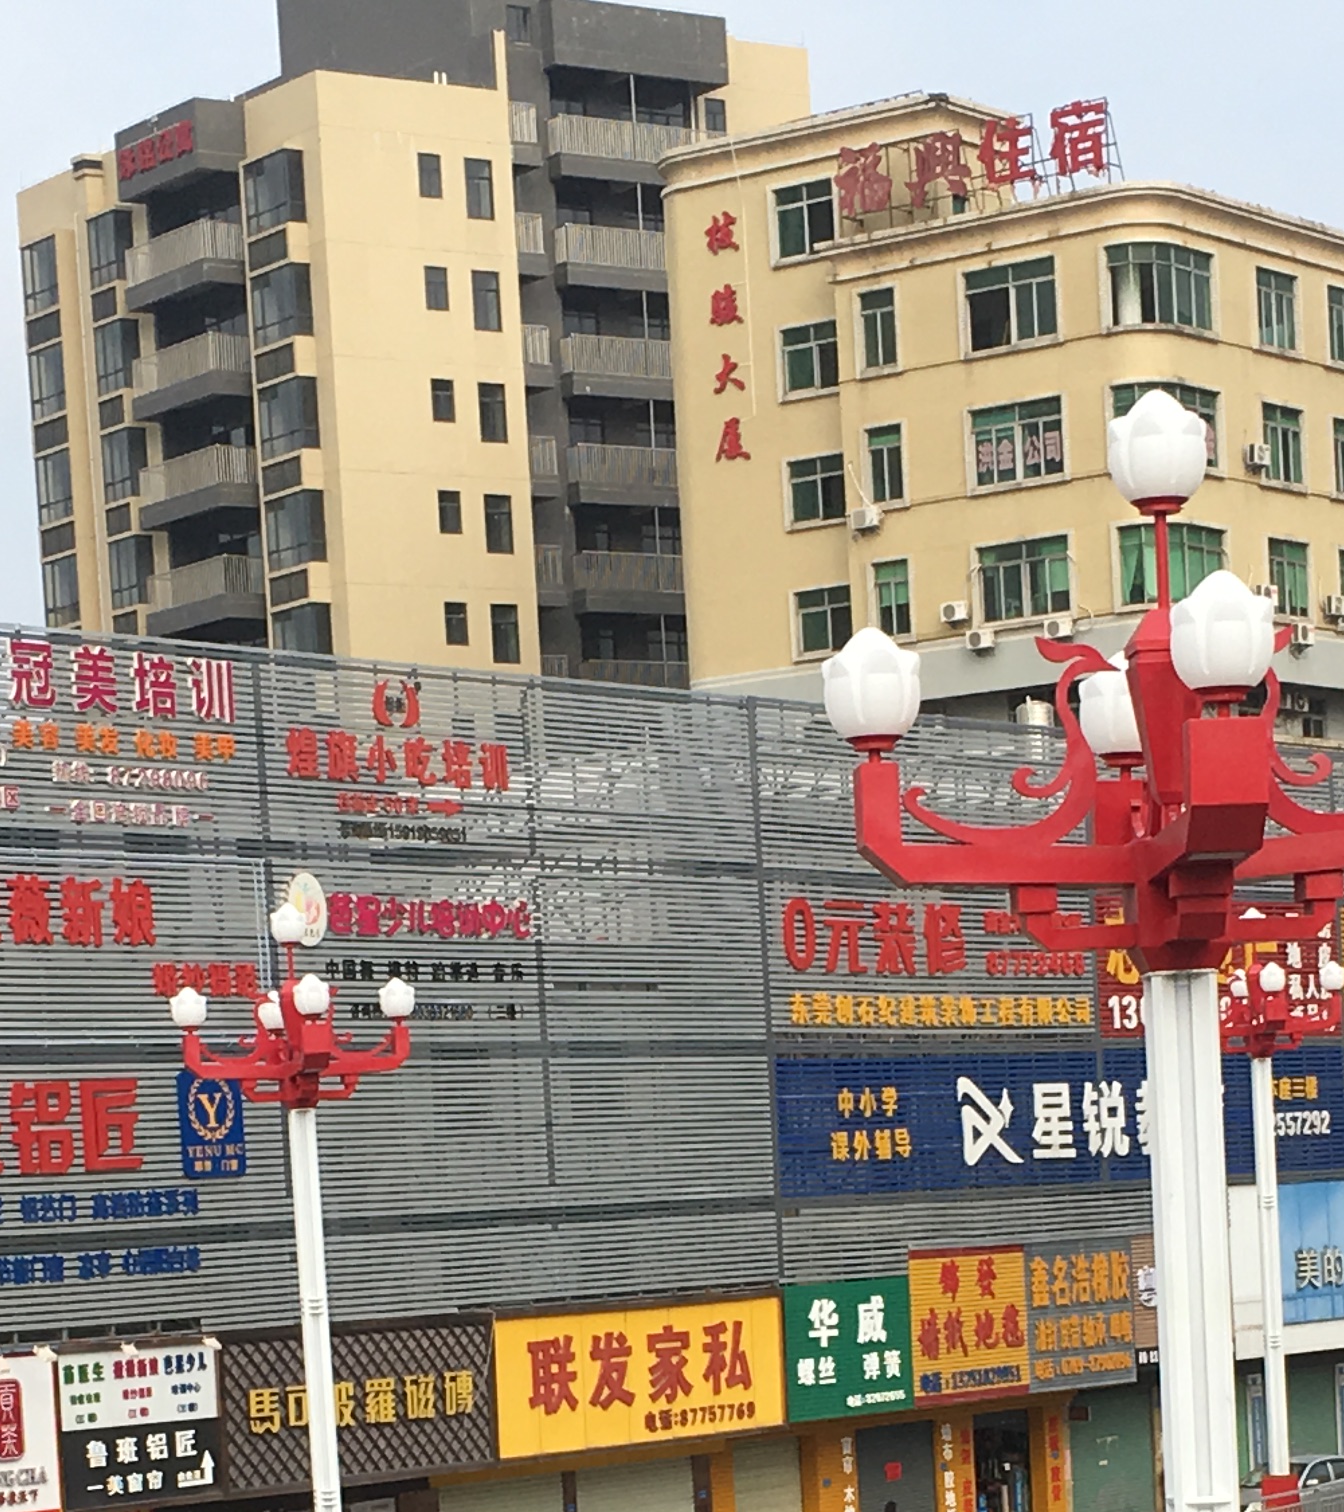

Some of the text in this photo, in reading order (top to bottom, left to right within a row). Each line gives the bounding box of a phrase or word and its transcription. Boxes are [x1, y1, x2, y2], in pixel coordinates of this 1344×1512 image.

[9, 639, 236, 724] 冠美培训
[12, 718, 59, 750] 美容
[75, 721, 119, 755] 美发
[193, 732, 237, 763] 美甲
[783, 897, 966, 976] 0元装修
[1108, 995, 1144, 1029] 13
[837, 1086, 899, 1119] 中小学
[830, 1128, 912, 1161] 课外辅导
[1295, 1246, 1344, 1289] 美的
[808, 1295, 887, 1347] 华威
[527, 1320, 752, 1415] 联发家私
[797, 1356, 837, 1385] 螺丝
[862, 1350, 902, 1380] 弹簧
[86, 1430, 197, 1468] 鲁班铝匠
